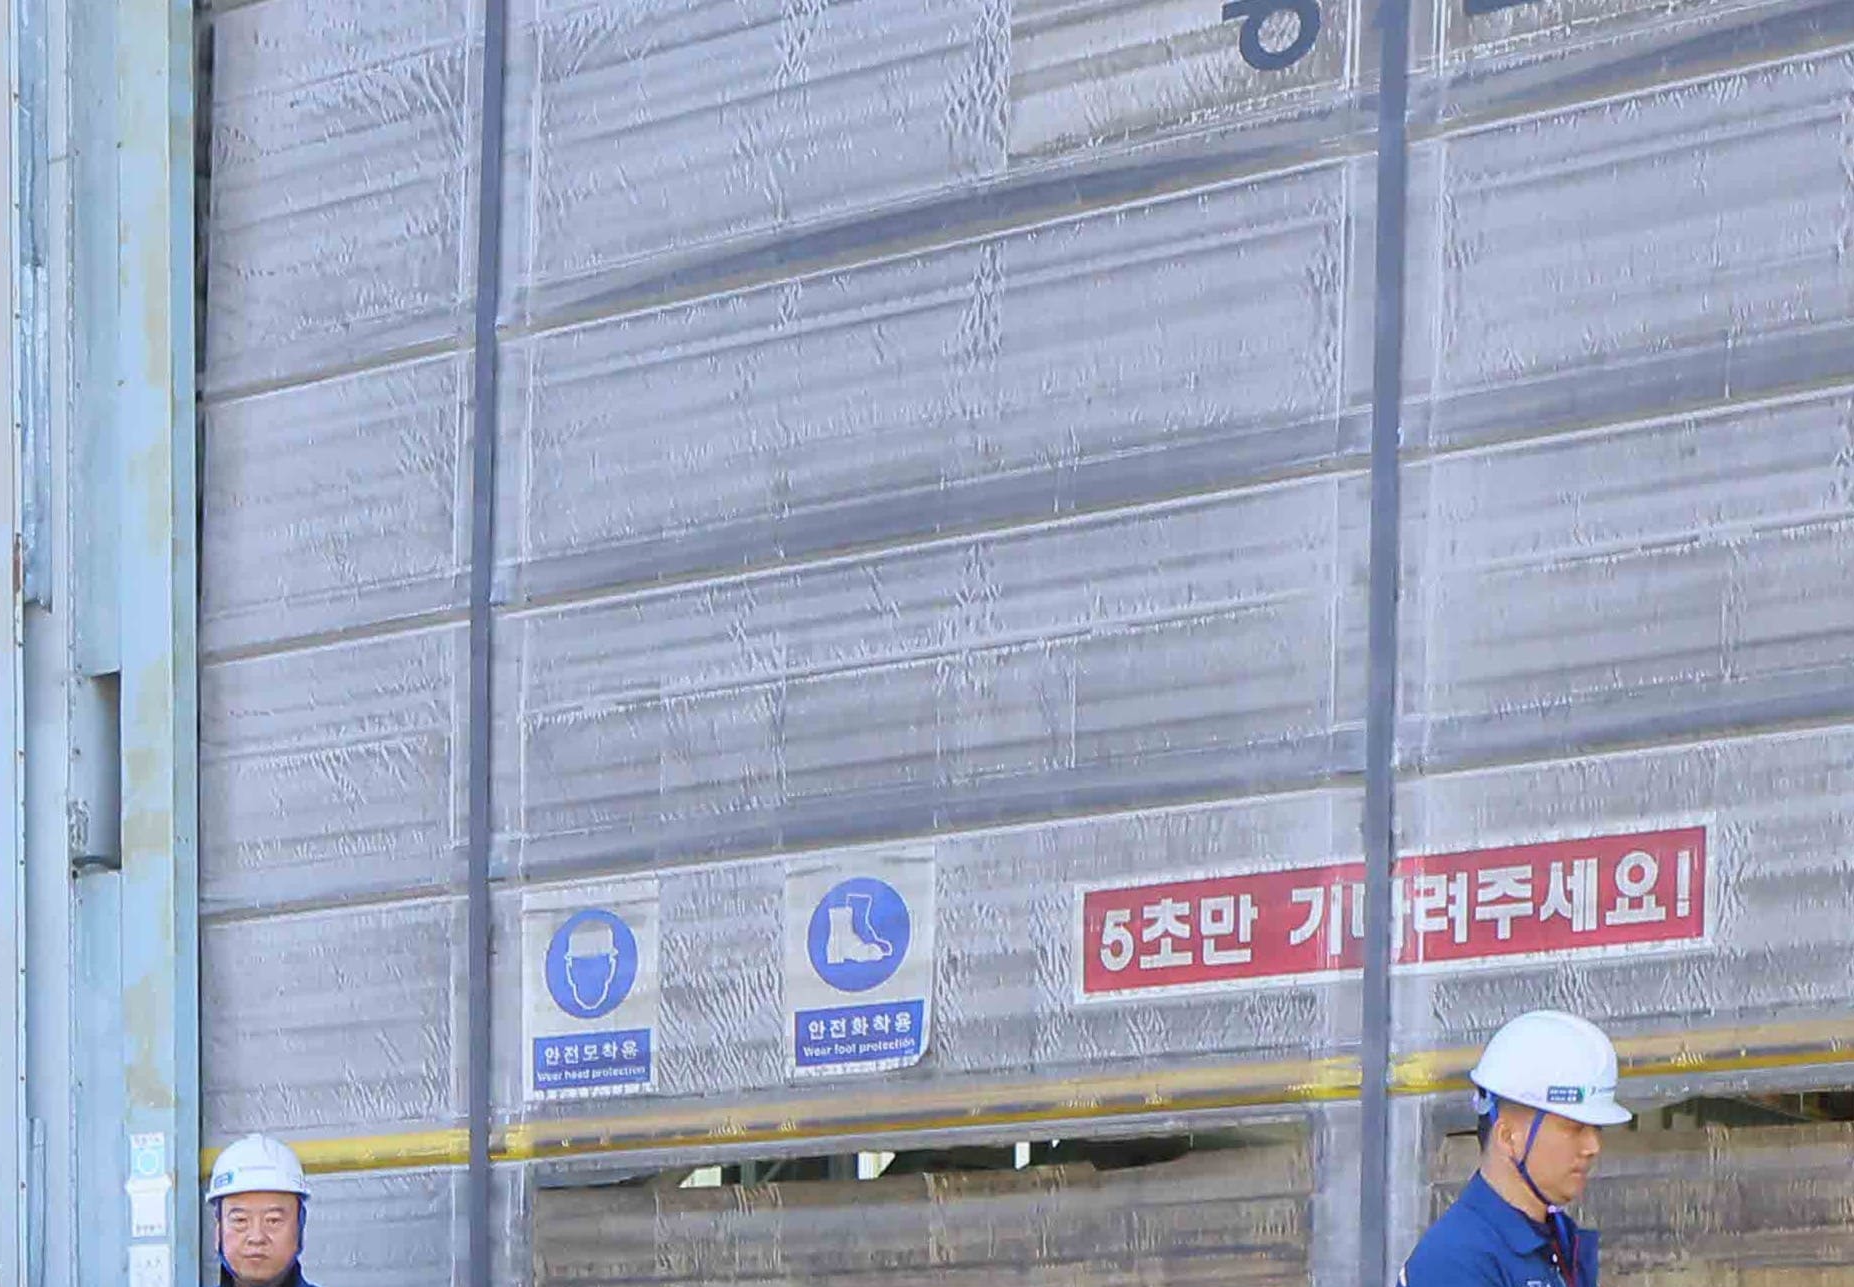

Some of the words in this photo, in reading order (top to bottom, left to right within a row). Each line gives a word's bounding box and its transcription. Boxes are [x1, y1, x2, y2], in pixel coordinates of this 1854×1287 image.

[1100, 894, 1259, 971] 5초만
[808, 1011, 912, 1040] 안전화착용
[544, 1040, 639, 1066] 안전모착용
[803, 1046, 833, 1057] Wear
[859, 1037, 915, 1053] protection
[591, 1066, 646, 1079] protection
